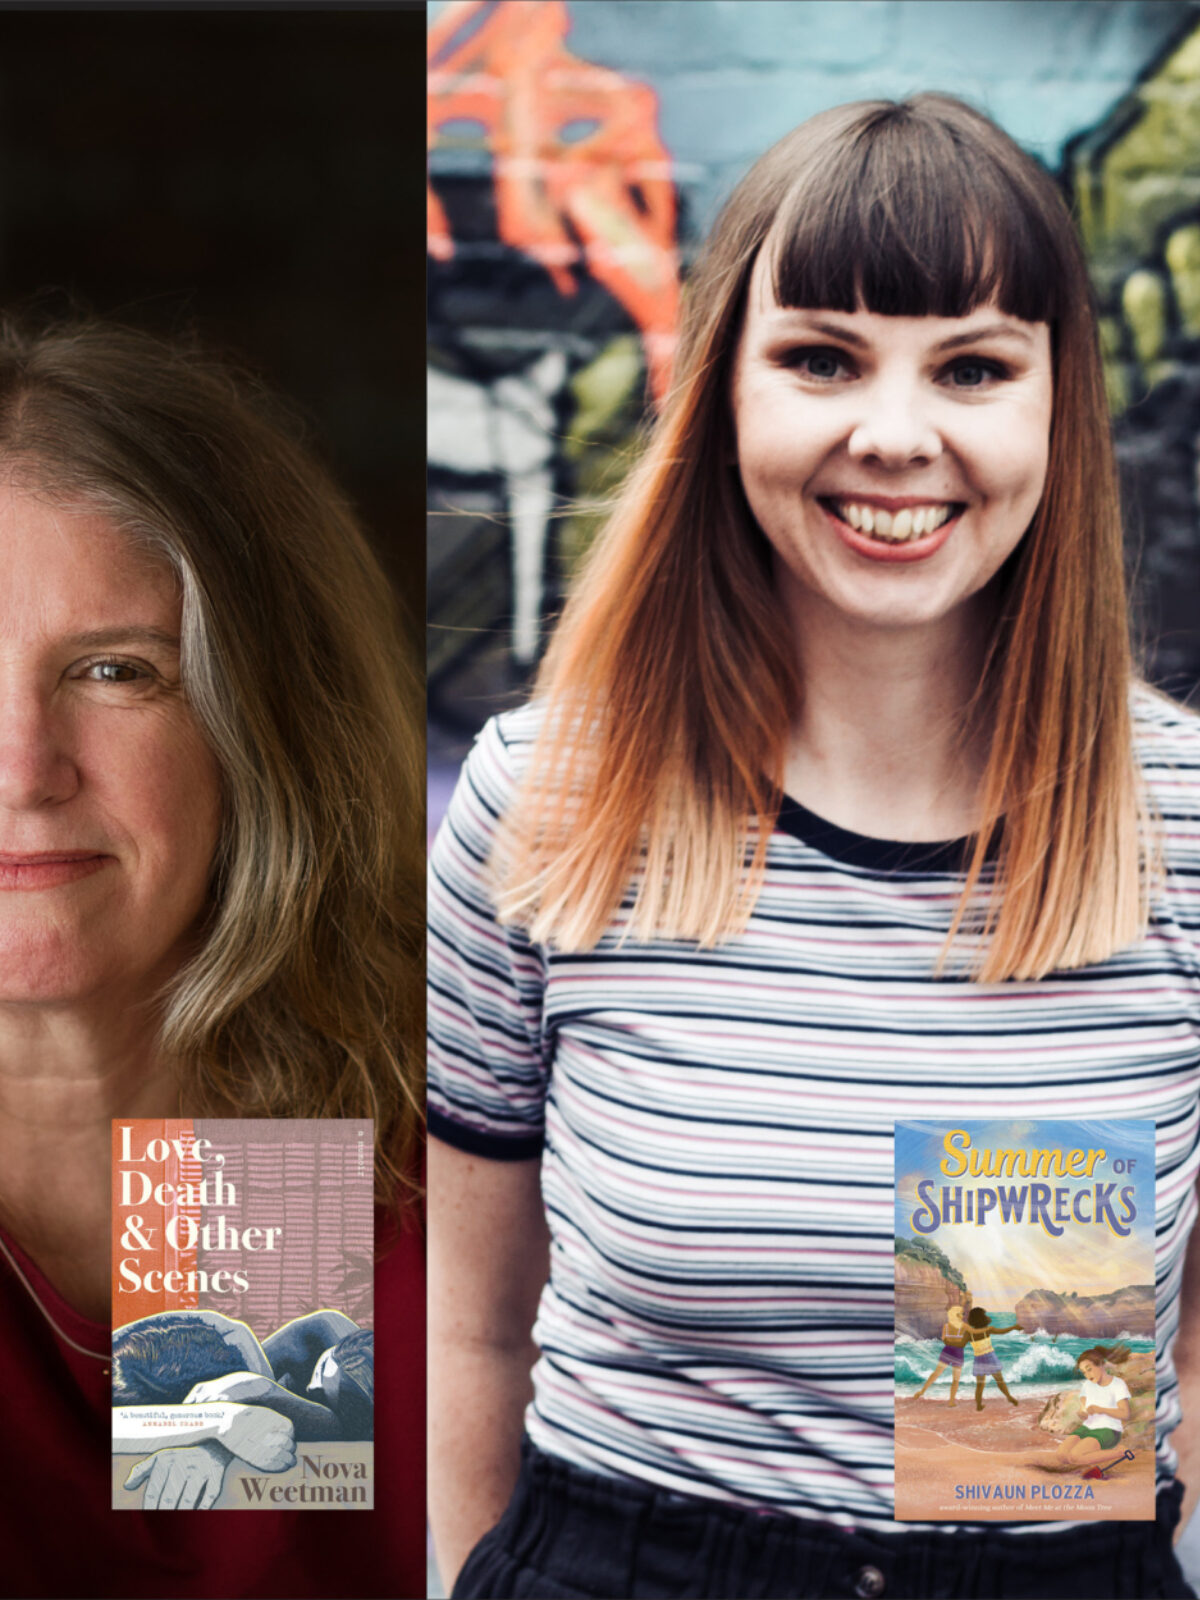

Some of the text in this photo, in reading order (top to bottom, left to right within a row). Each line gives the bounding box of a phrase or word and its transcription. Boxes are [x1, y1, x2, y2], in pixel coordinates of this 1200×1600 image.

[118, 1126, 226, 1169] Love,
[939, 1129, 1137, 1179] Summer OF
[118, 1170, 237, 1206] Death
[912, 1179, 1137, 1238] SHIPWRECKS
[120, 1215, 282, 1251] & Other
[118, 1257, 249, 1294] Scenes
[299, 1455, 367, 1480] Nova
[239, 1477, 367, 1503] Weetman
[955, 1485, 1095, 1499] SHIVAUN PLOZZA
